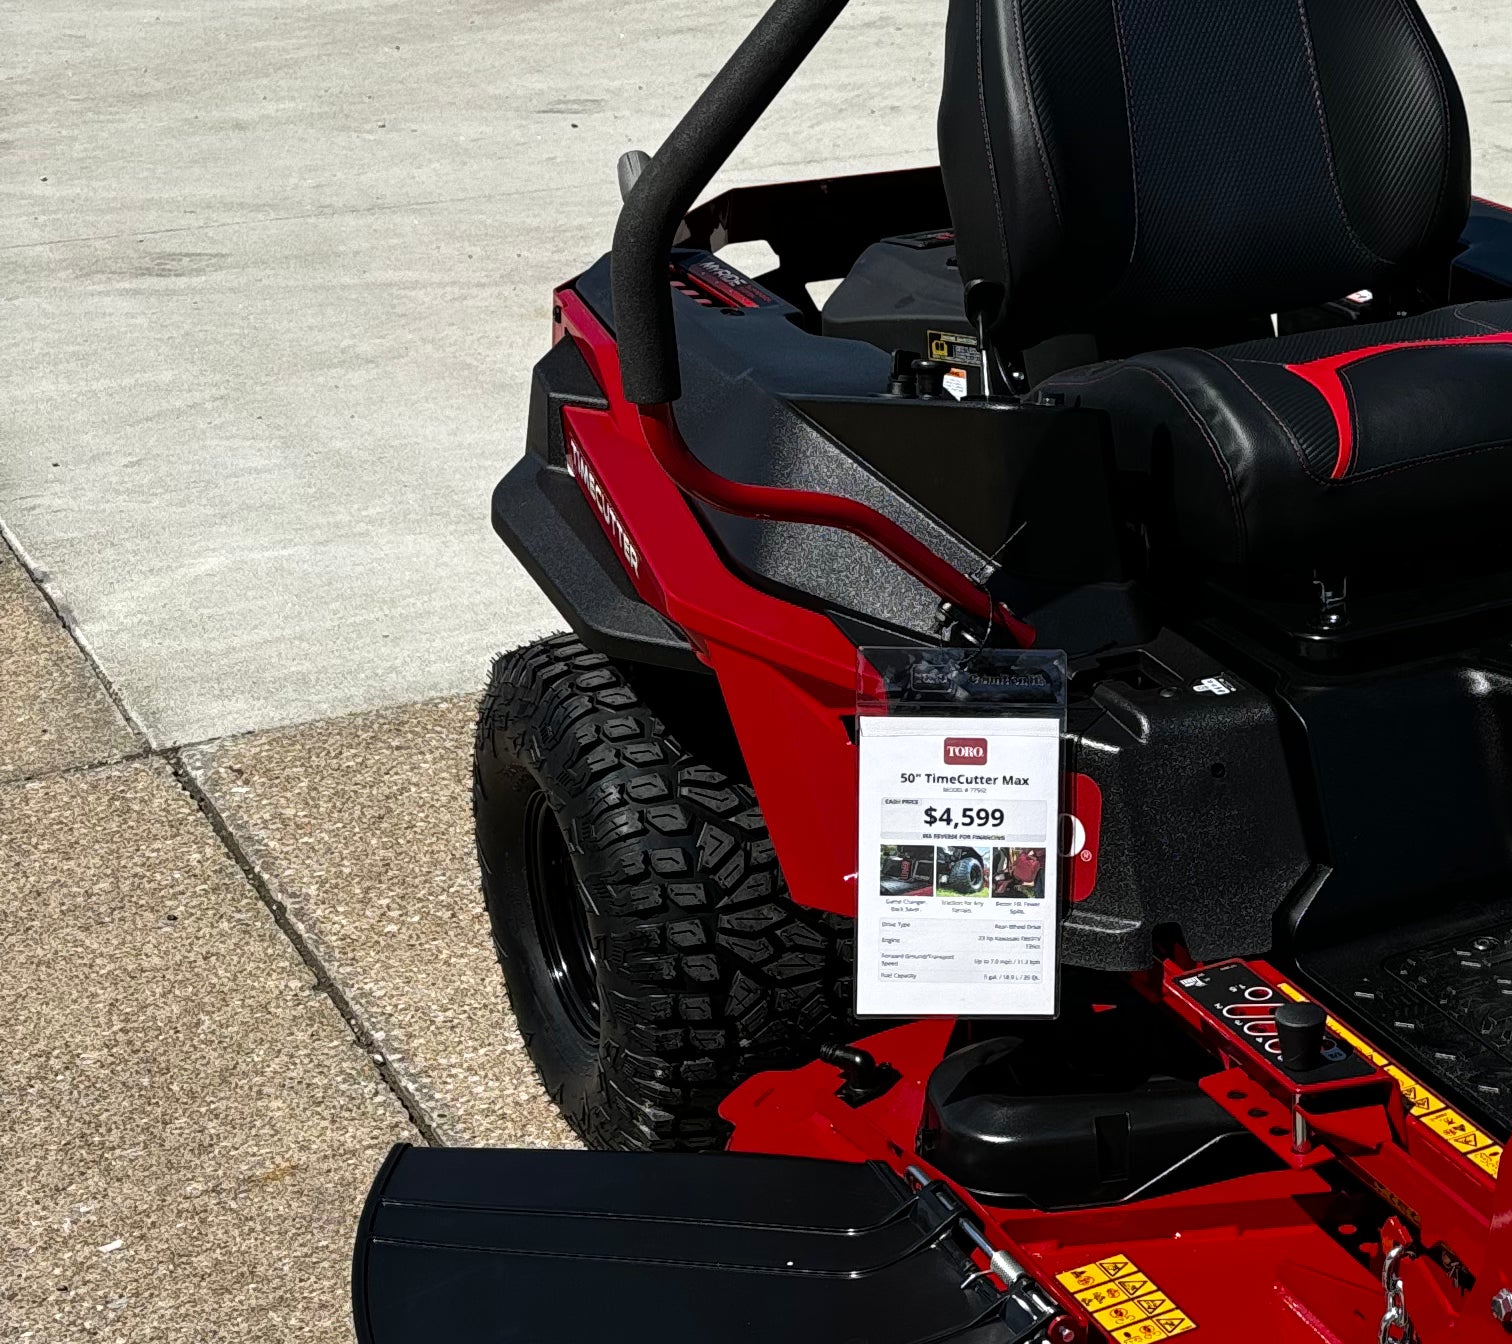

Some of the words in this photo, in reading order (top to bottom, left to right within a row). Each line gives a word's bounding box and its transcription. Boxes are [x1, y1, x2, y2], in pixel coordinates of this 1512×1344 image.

[570, 439, 641, 580] TIMECUTTER
[947, 746, 984, 757] TORO
[925, 773, 998, 785] TimeCutter
[1002, 775, 1029, 786] Max
[924, 806, 1004, 829] $4,599
